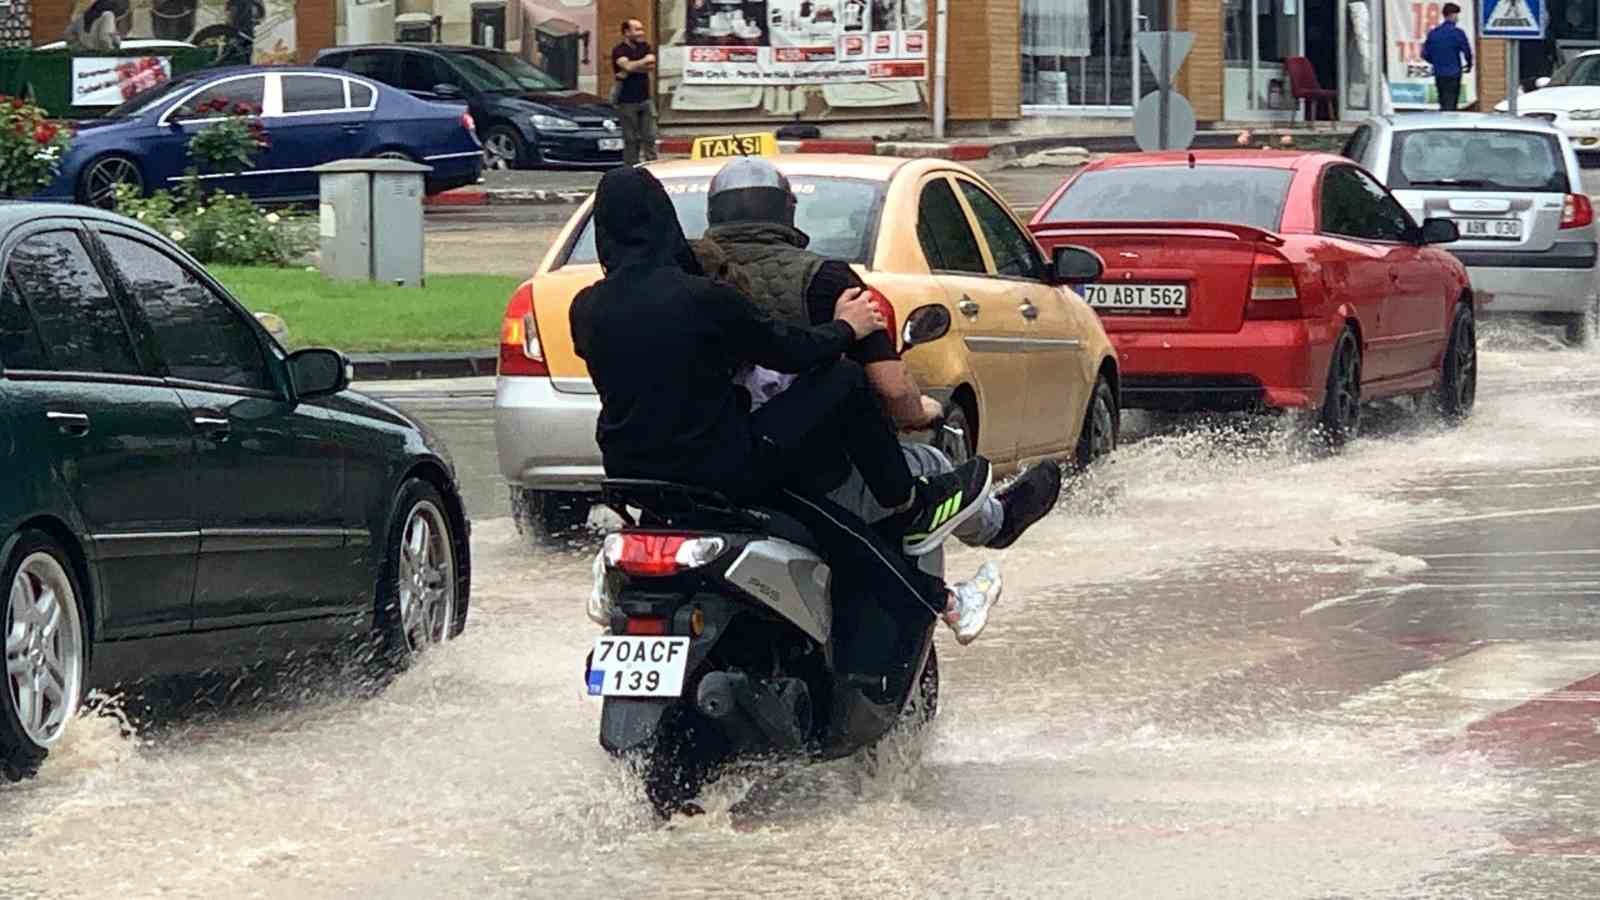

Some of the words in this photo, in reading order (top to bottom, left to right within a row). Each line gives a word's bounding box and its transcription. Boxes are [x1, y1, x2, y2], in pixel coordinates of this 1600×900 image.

[1086, 287, 1107, 305] 70
[1113, 287, 1145, 305] ABT
[1150, 288, 1184, 305] 562
[599, 640, 684, 664] 70ACF
[613, 670, 660, 692] 139
